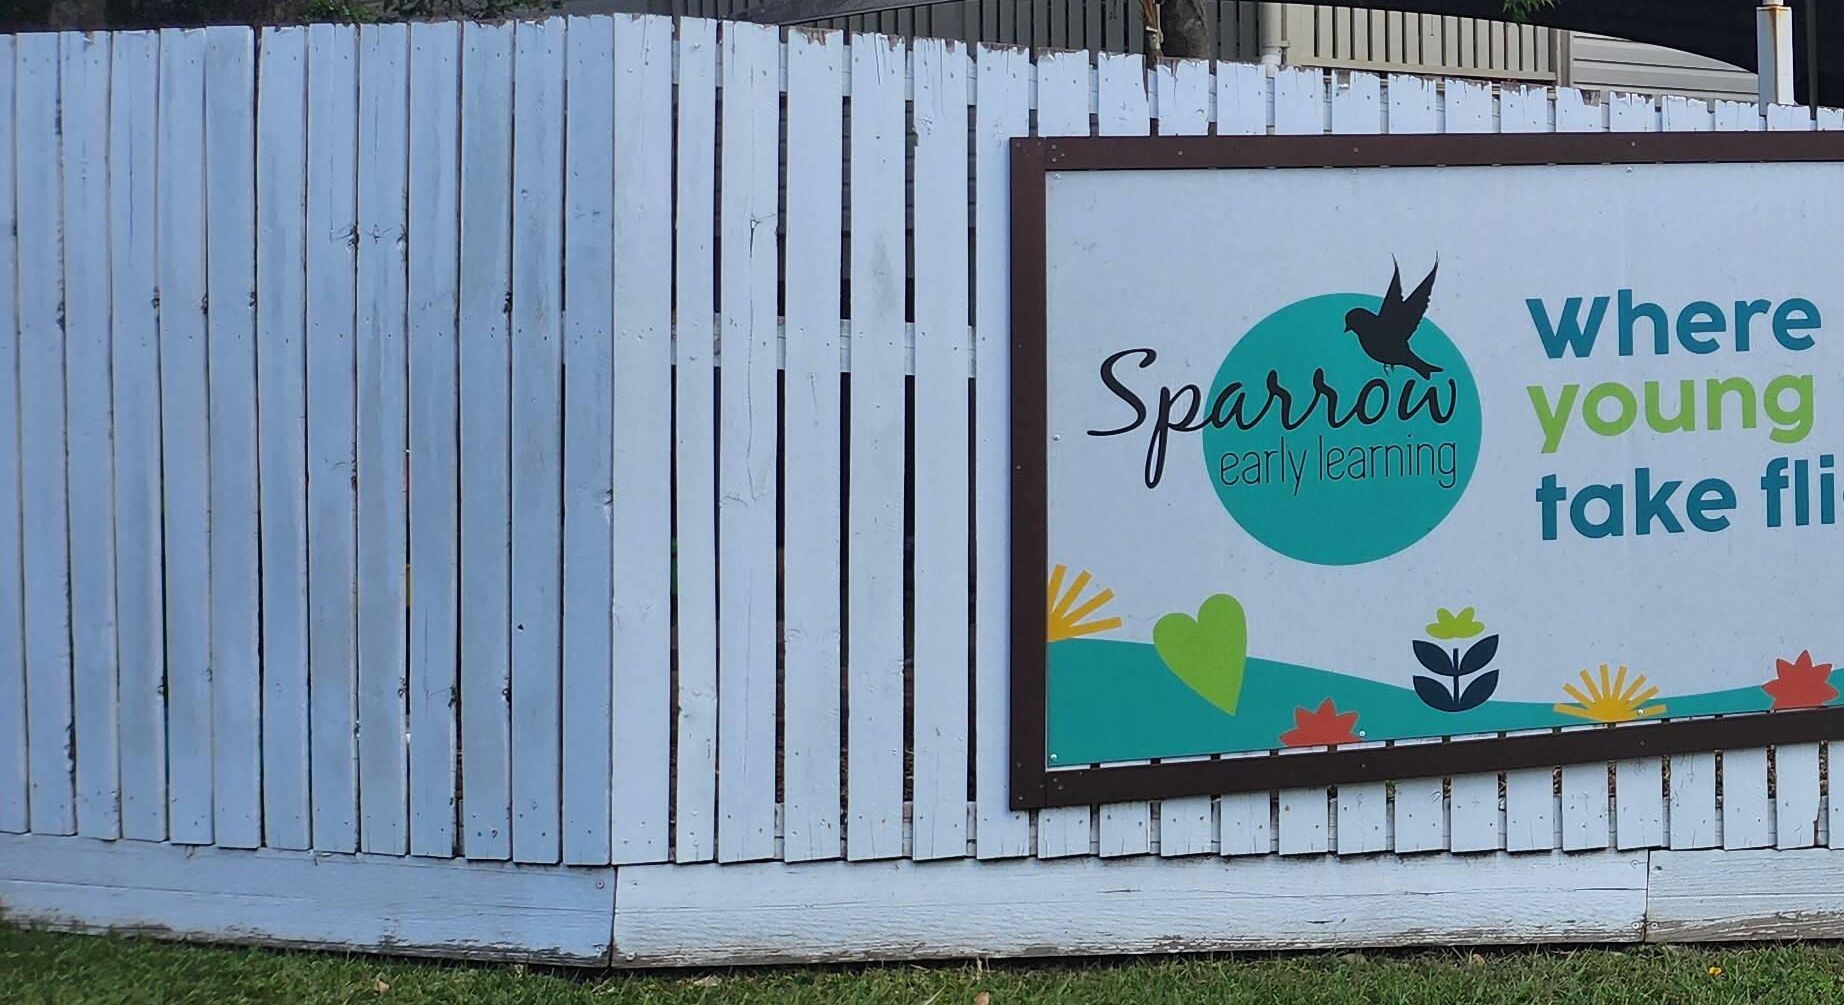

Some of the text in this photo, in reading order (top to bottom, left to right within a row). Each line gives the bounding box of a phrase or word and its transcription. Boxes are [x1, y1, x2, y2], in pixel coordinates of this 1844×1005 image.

[1525, 289, 1822, 358] Where
[1087, 348, 1457, 489] Sparrow
[1526, 373, 1814, 453] young
[1220, 434, 1457, 496] early learning
[1536, 467, 1737, 540] take
